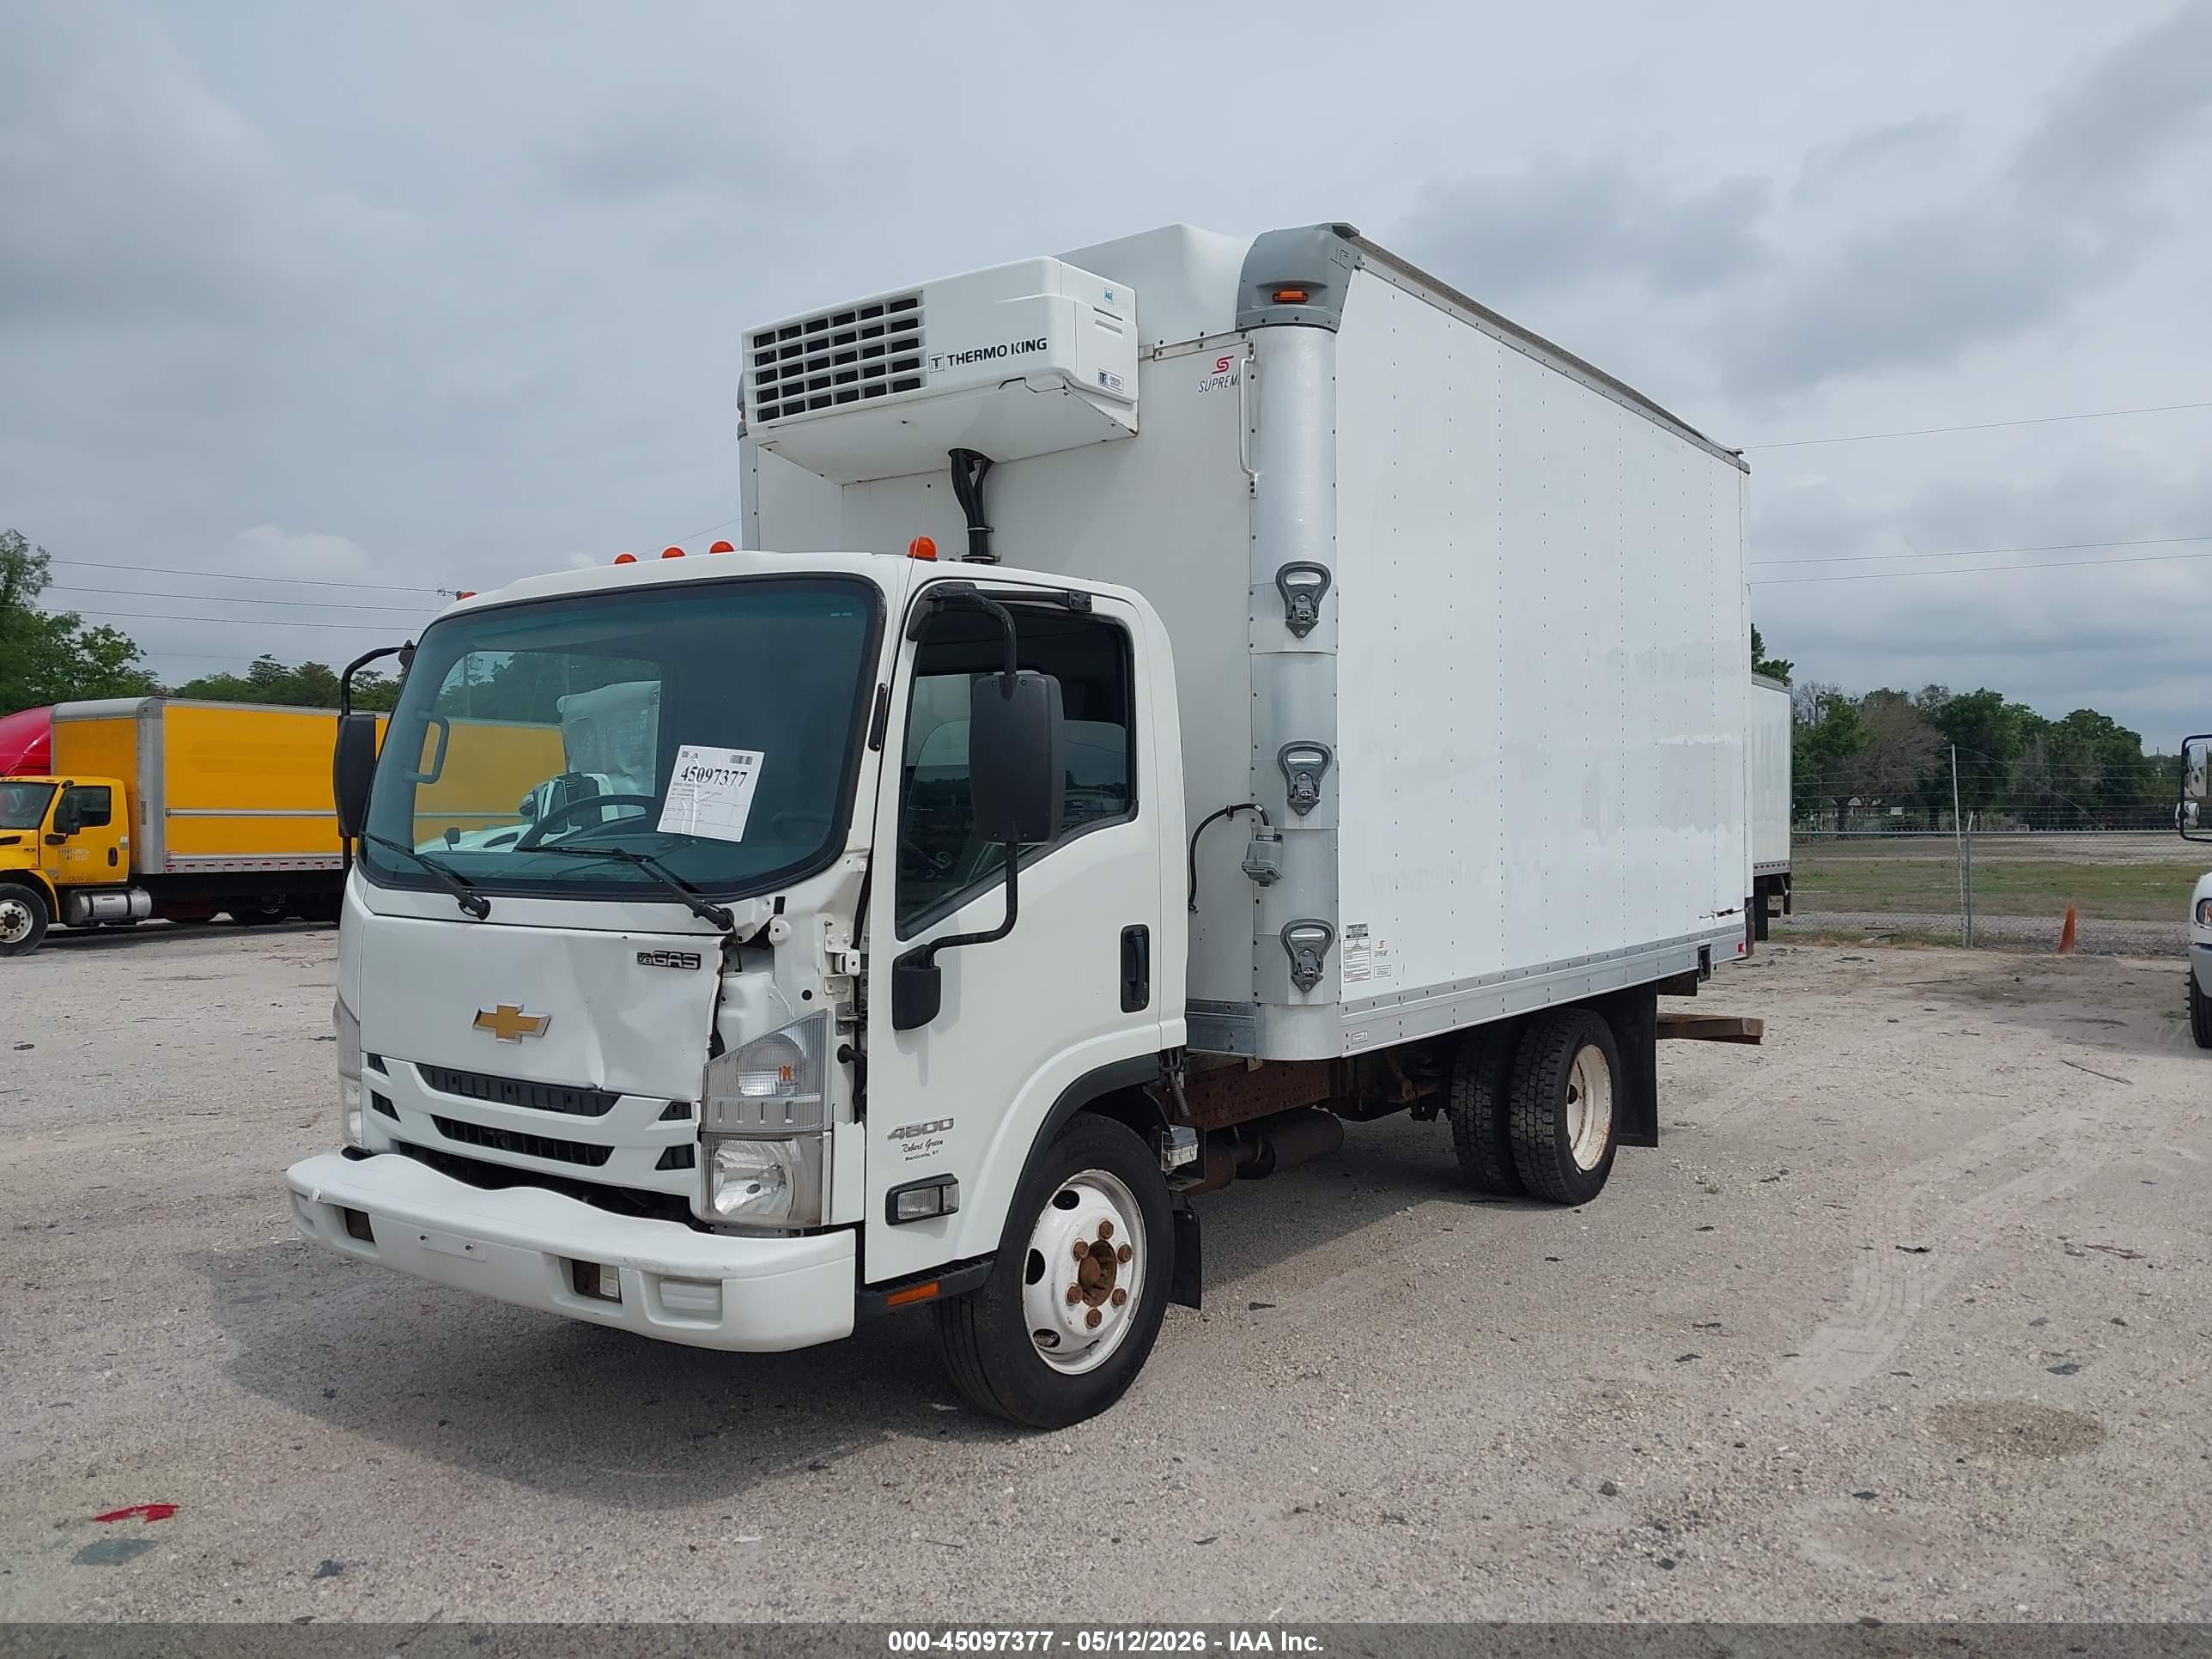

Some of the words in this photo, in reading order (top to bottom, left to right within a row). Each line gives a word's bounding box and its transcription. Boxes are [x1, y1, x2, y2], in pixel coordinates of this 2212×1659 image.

[947, 345, 1007, 367] THERMO
[1011, 337, 1048, 356] KING
[680, 765, 748, 788] 45097377
[900, 1141, 923, 1154] Robert
[925, 1139, 944, 1152] Green
